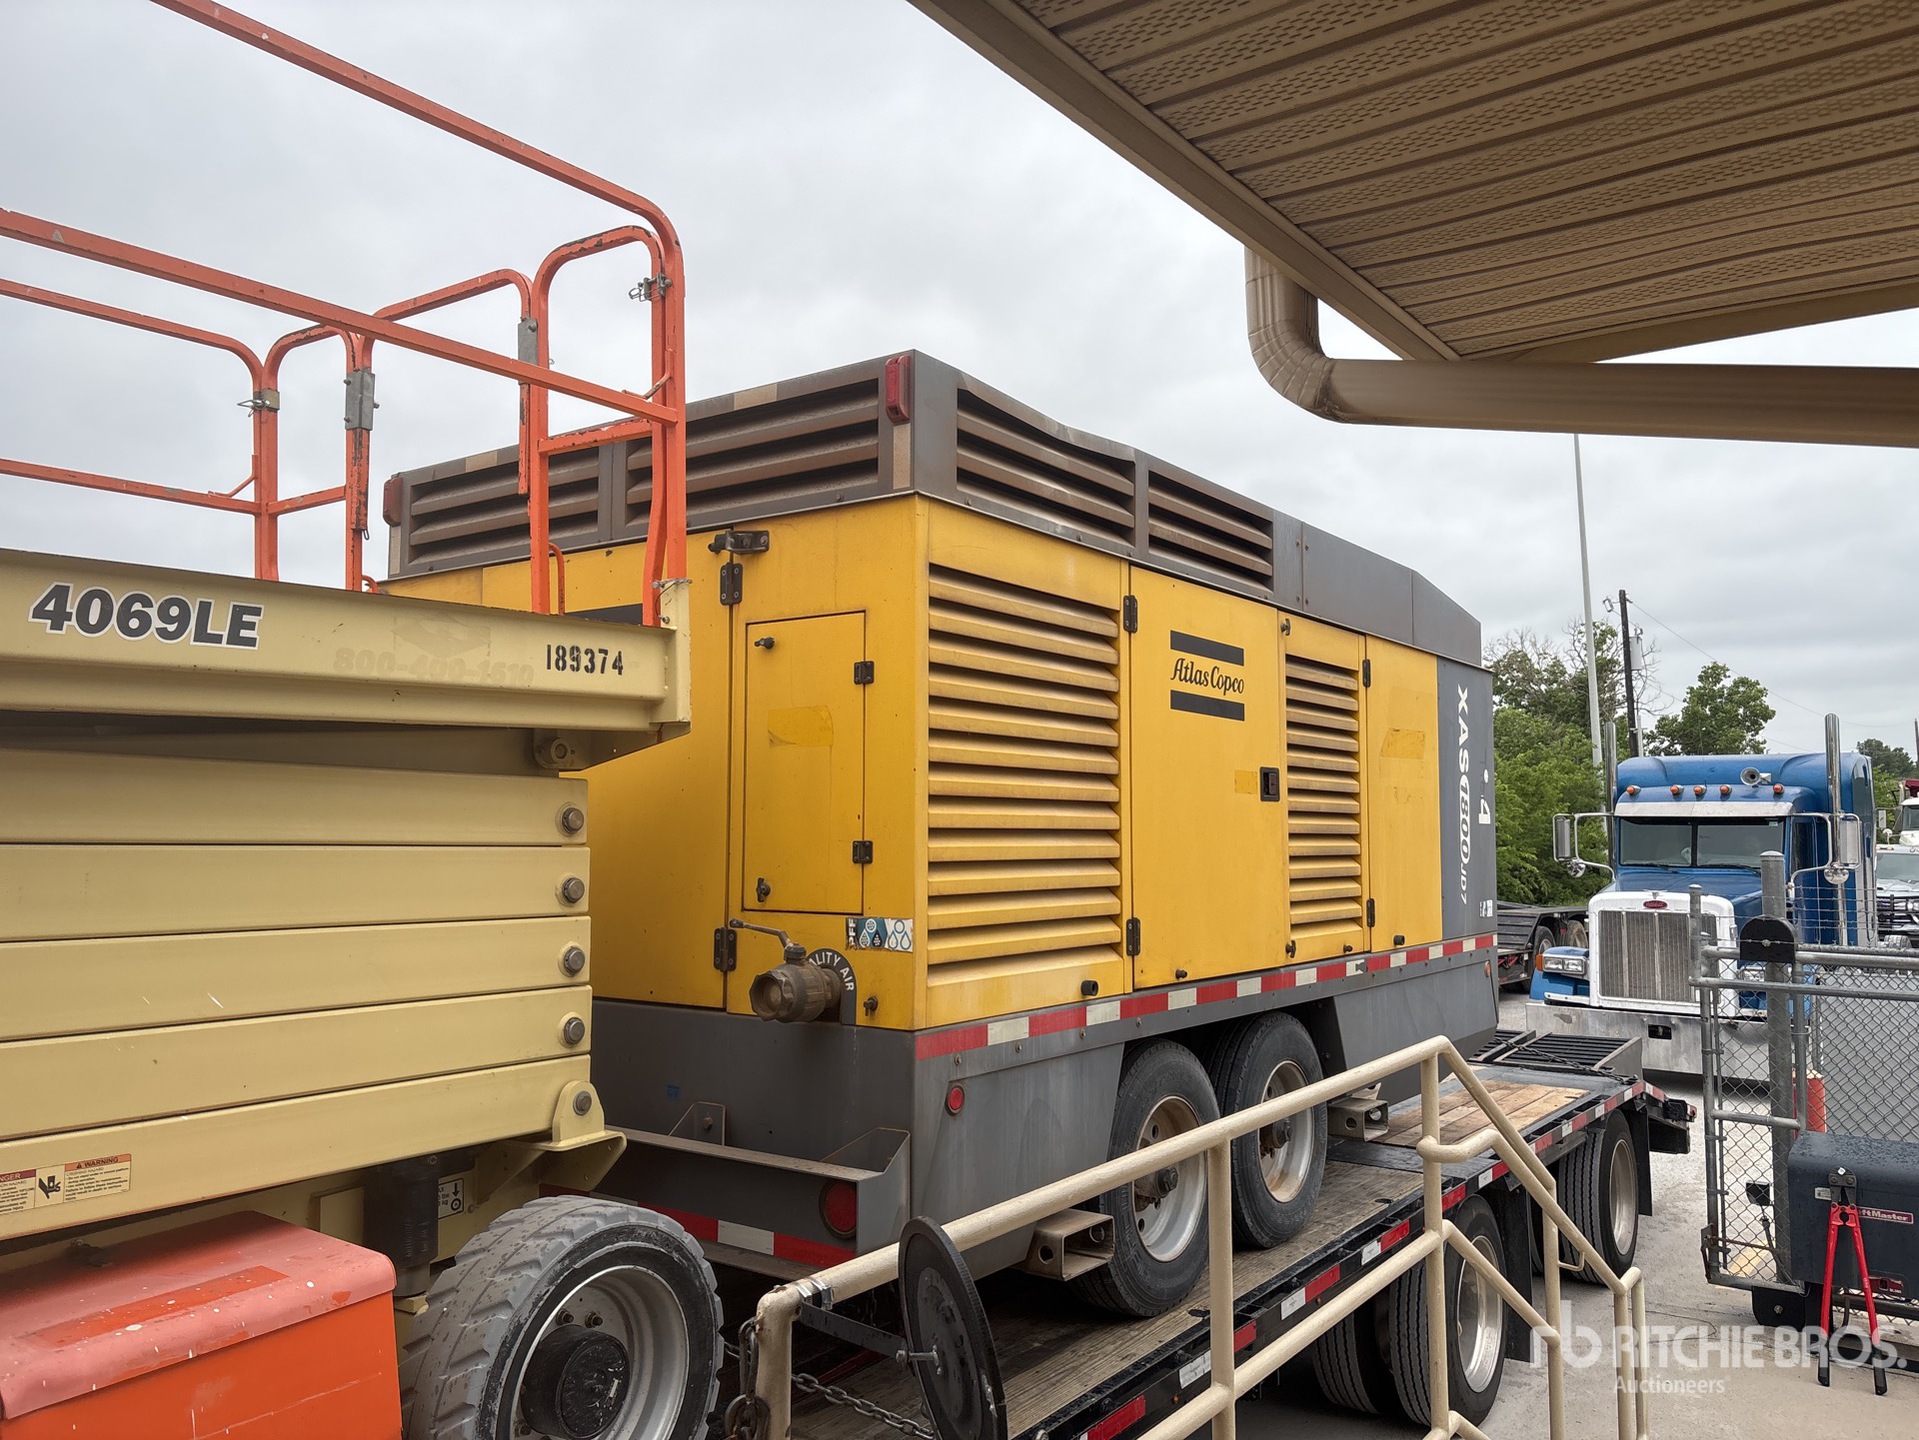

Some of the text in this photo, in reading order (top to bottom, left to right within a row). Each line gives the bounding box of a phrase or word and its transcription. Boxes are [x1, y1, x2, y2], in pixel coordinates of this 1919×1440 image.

[28, 582, 264, 650] 4069LE
[546, 644, 624, 675] 189374
[1170, 658, 1244, 696] Atlas Copco
[840, 967, 855, 991] AIR
[84, 1156, 119, 1168] WARNING
